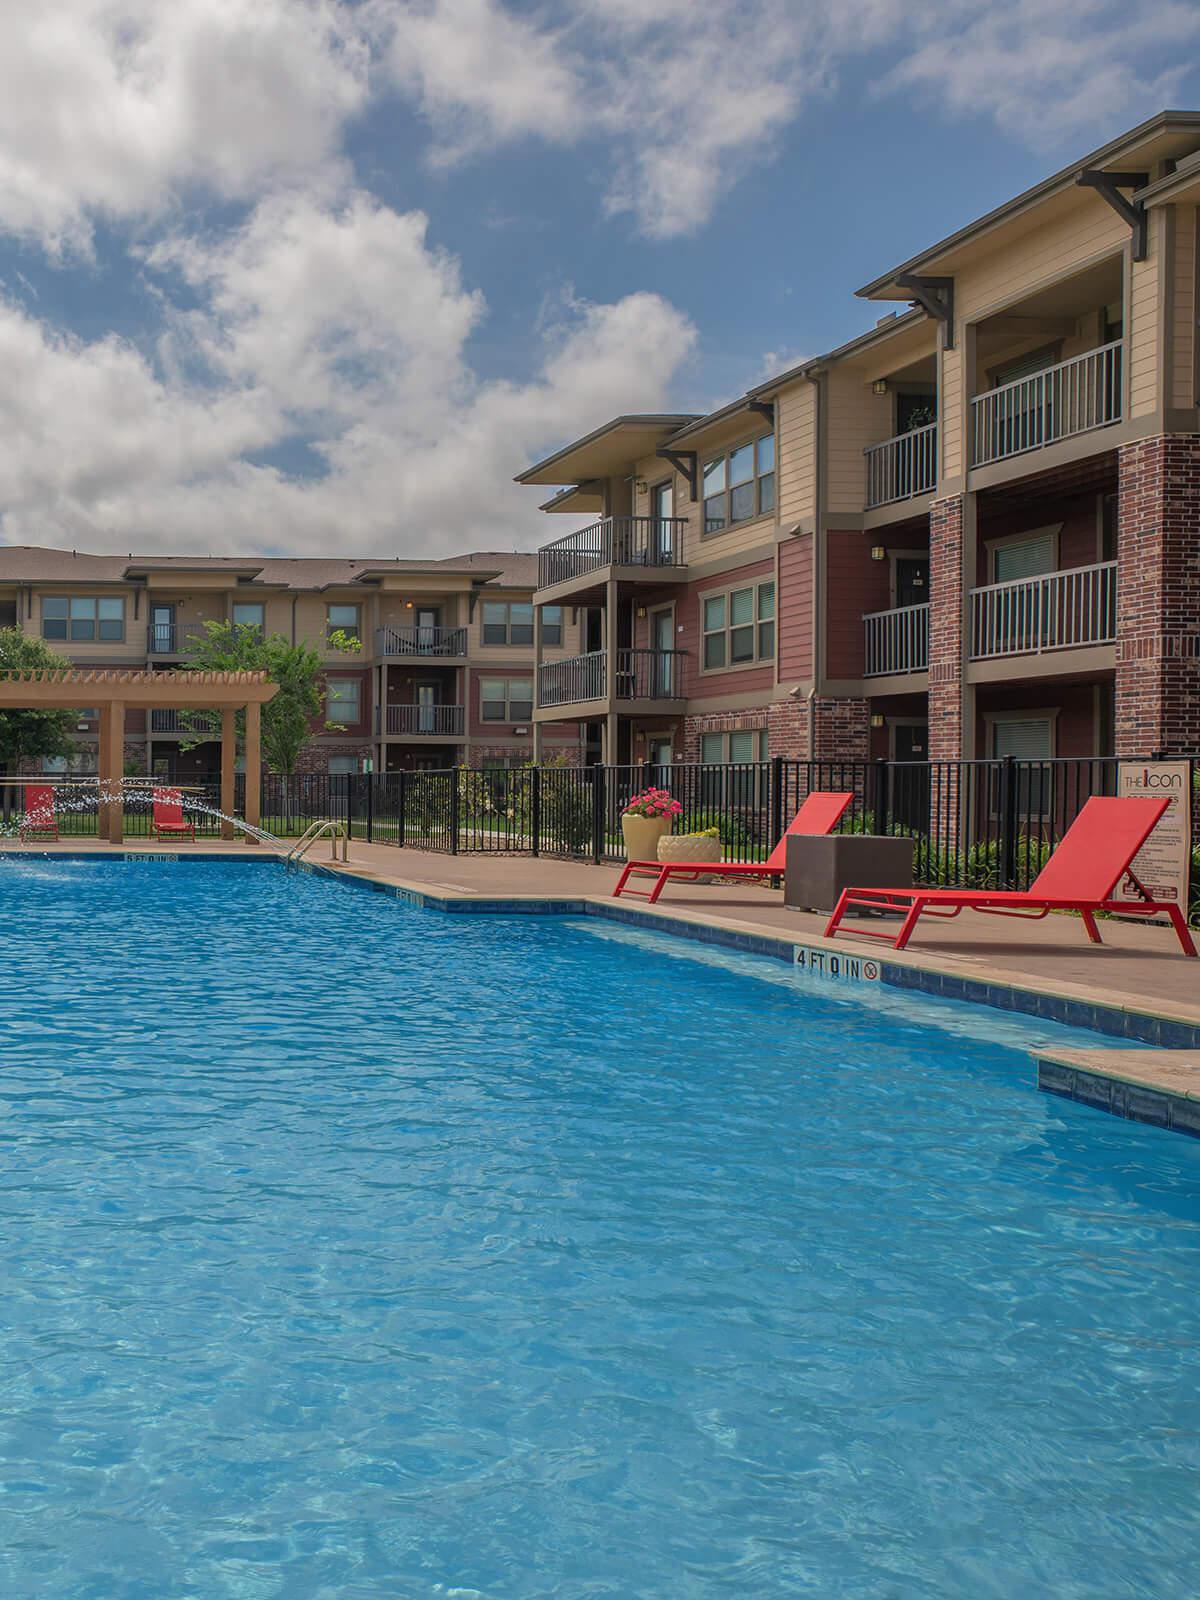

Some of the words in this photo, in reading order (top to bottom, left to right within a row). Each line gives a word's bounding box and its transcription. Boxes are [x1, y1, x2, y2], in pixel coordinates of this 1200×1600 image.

[1124, 776, 1142, 788] THE
[797, 949, 806, 969] 4
[810, 951, 825, 970] FT
[830, 956, 840, 974] 0
[845, 959, 860, 977] IN
